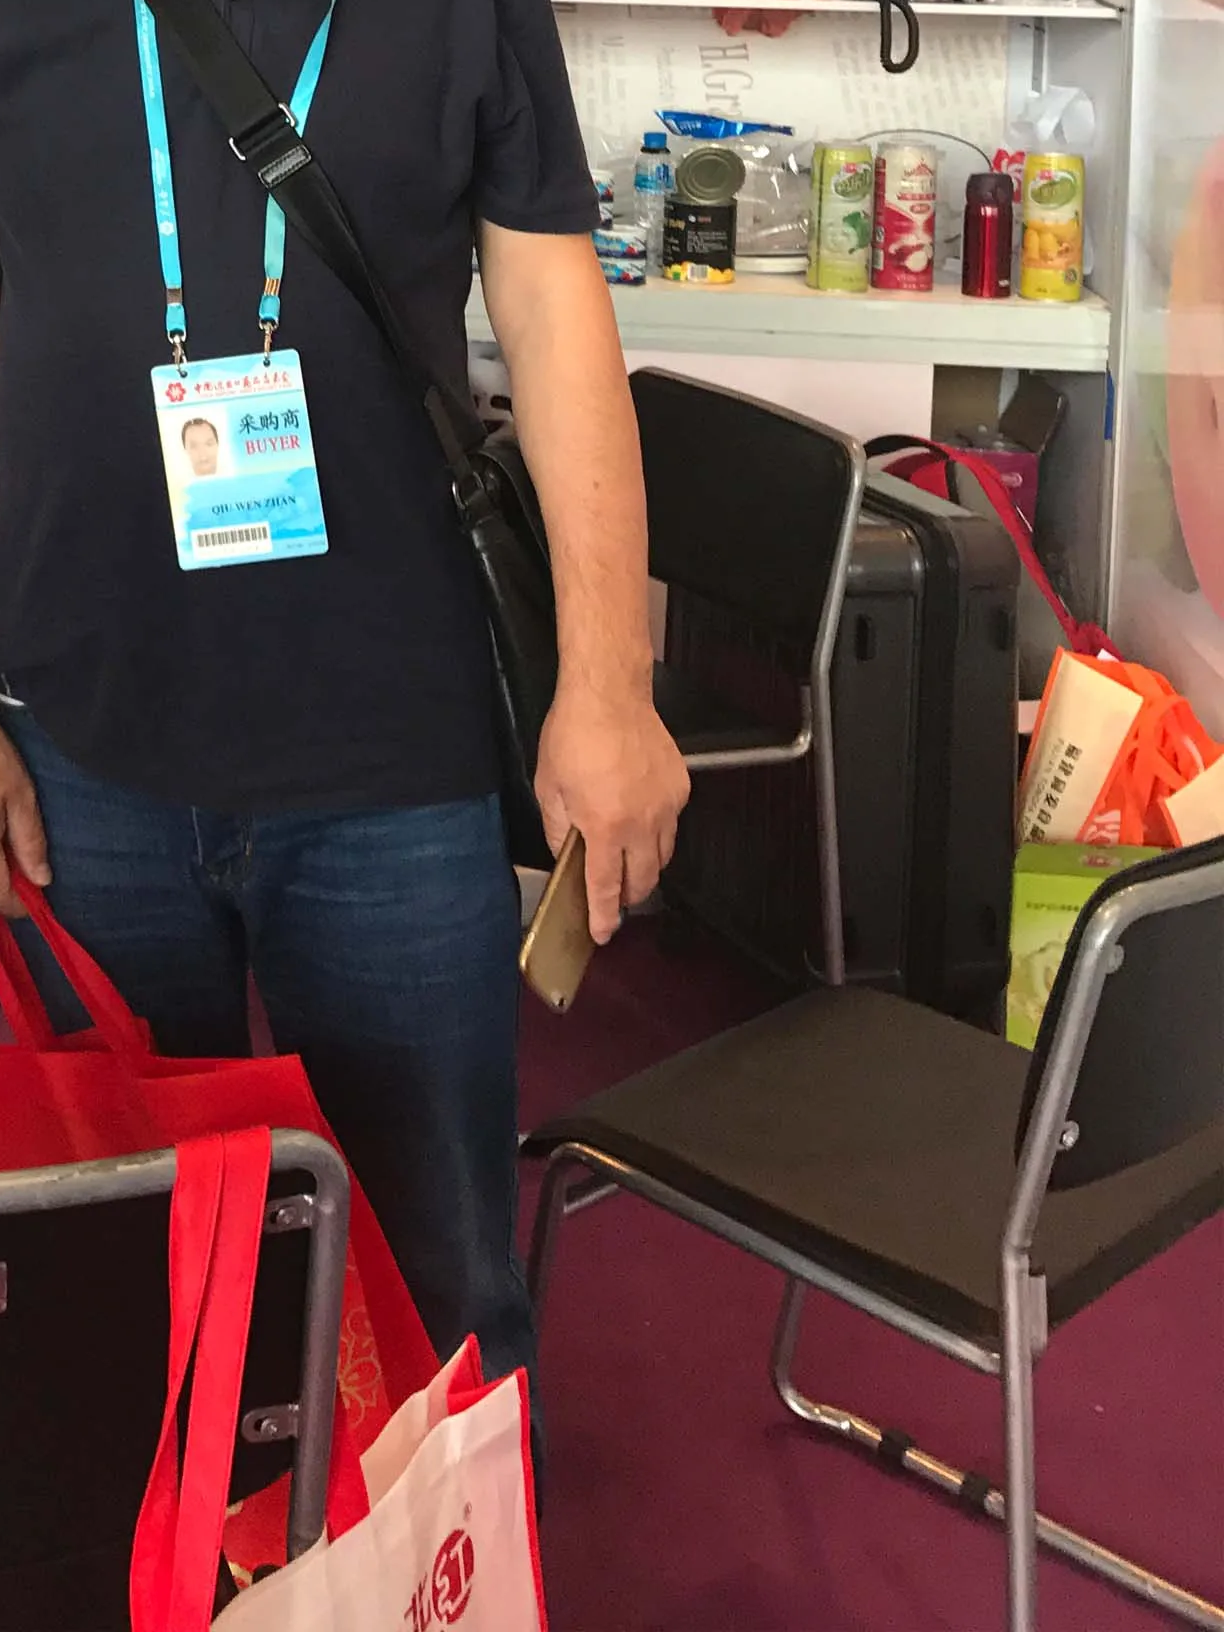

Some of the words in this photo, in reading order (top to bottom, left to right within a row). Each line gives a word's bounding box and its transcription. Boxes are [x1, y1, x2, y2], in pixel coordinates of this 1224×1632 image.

[239, 409, 301, 435] 采购商
[245, 434, 301, 456] BUYER
